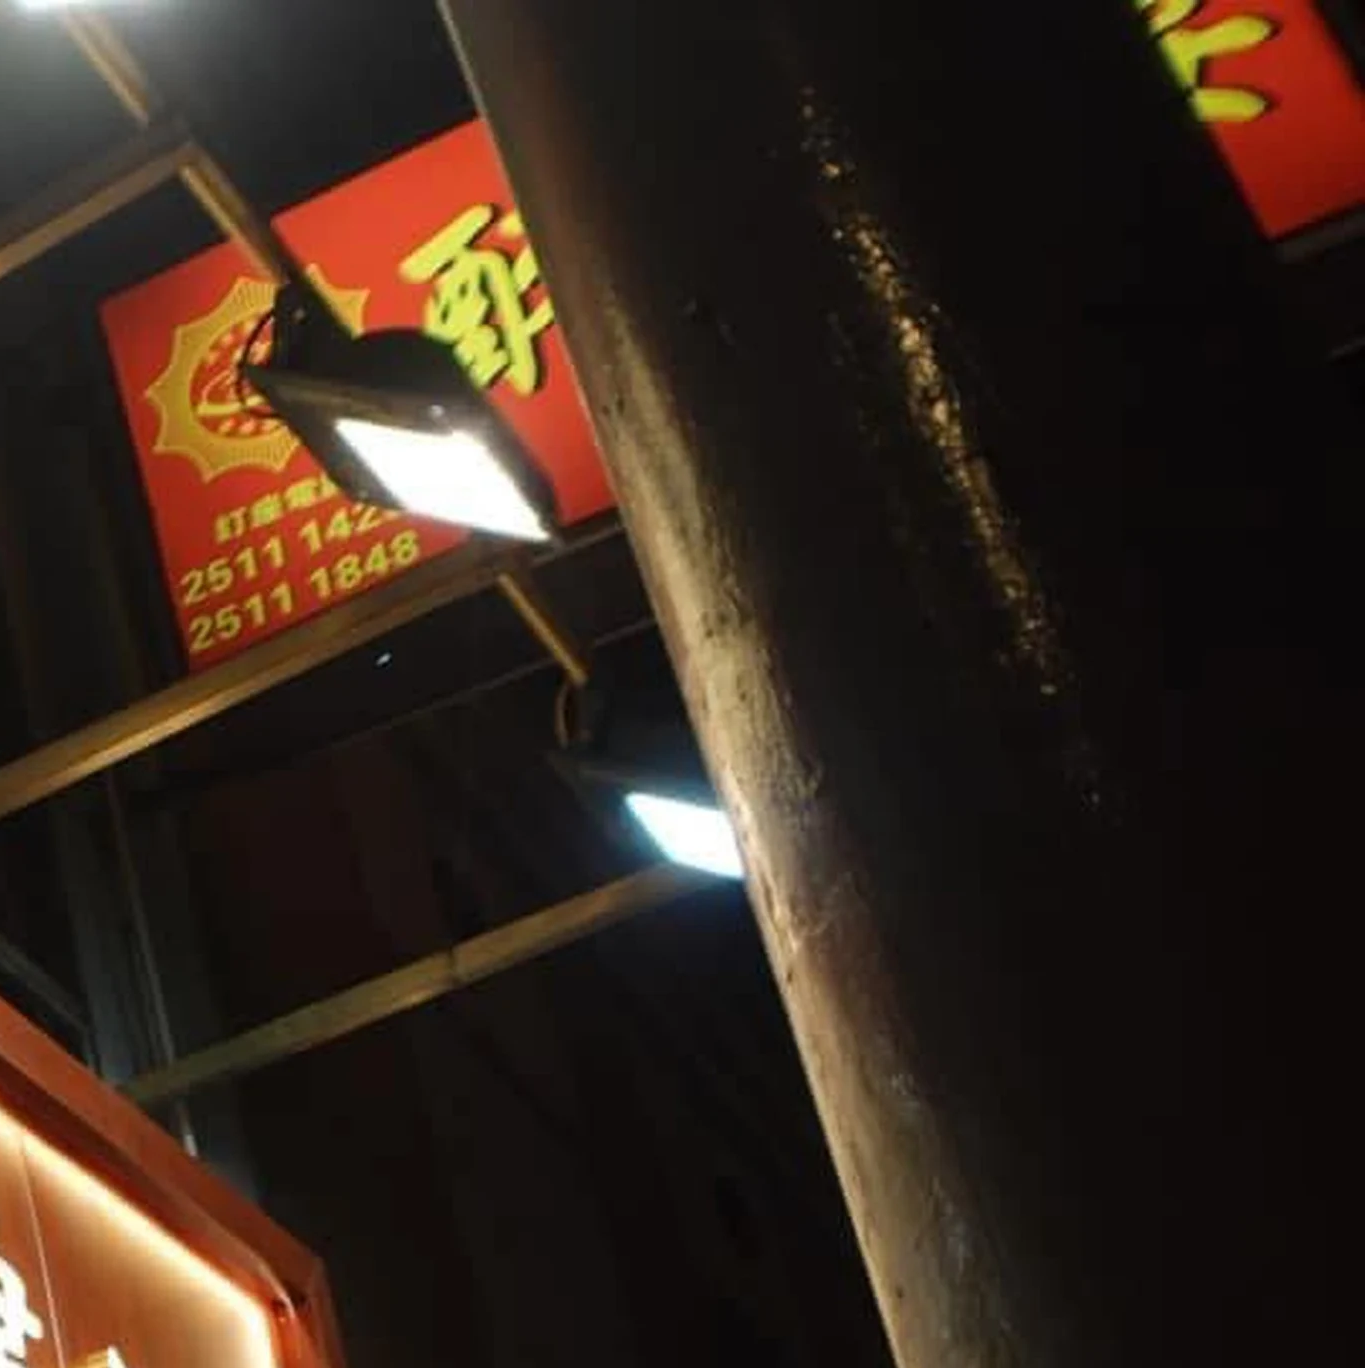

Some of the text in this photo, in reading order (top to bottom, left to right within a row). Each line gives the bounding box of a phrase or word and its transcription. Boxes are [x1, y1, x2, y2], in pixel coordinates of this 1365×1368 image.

[181, 502, 401, 606] 2511 142
[189, 529, 420, 652] 2511 1848
